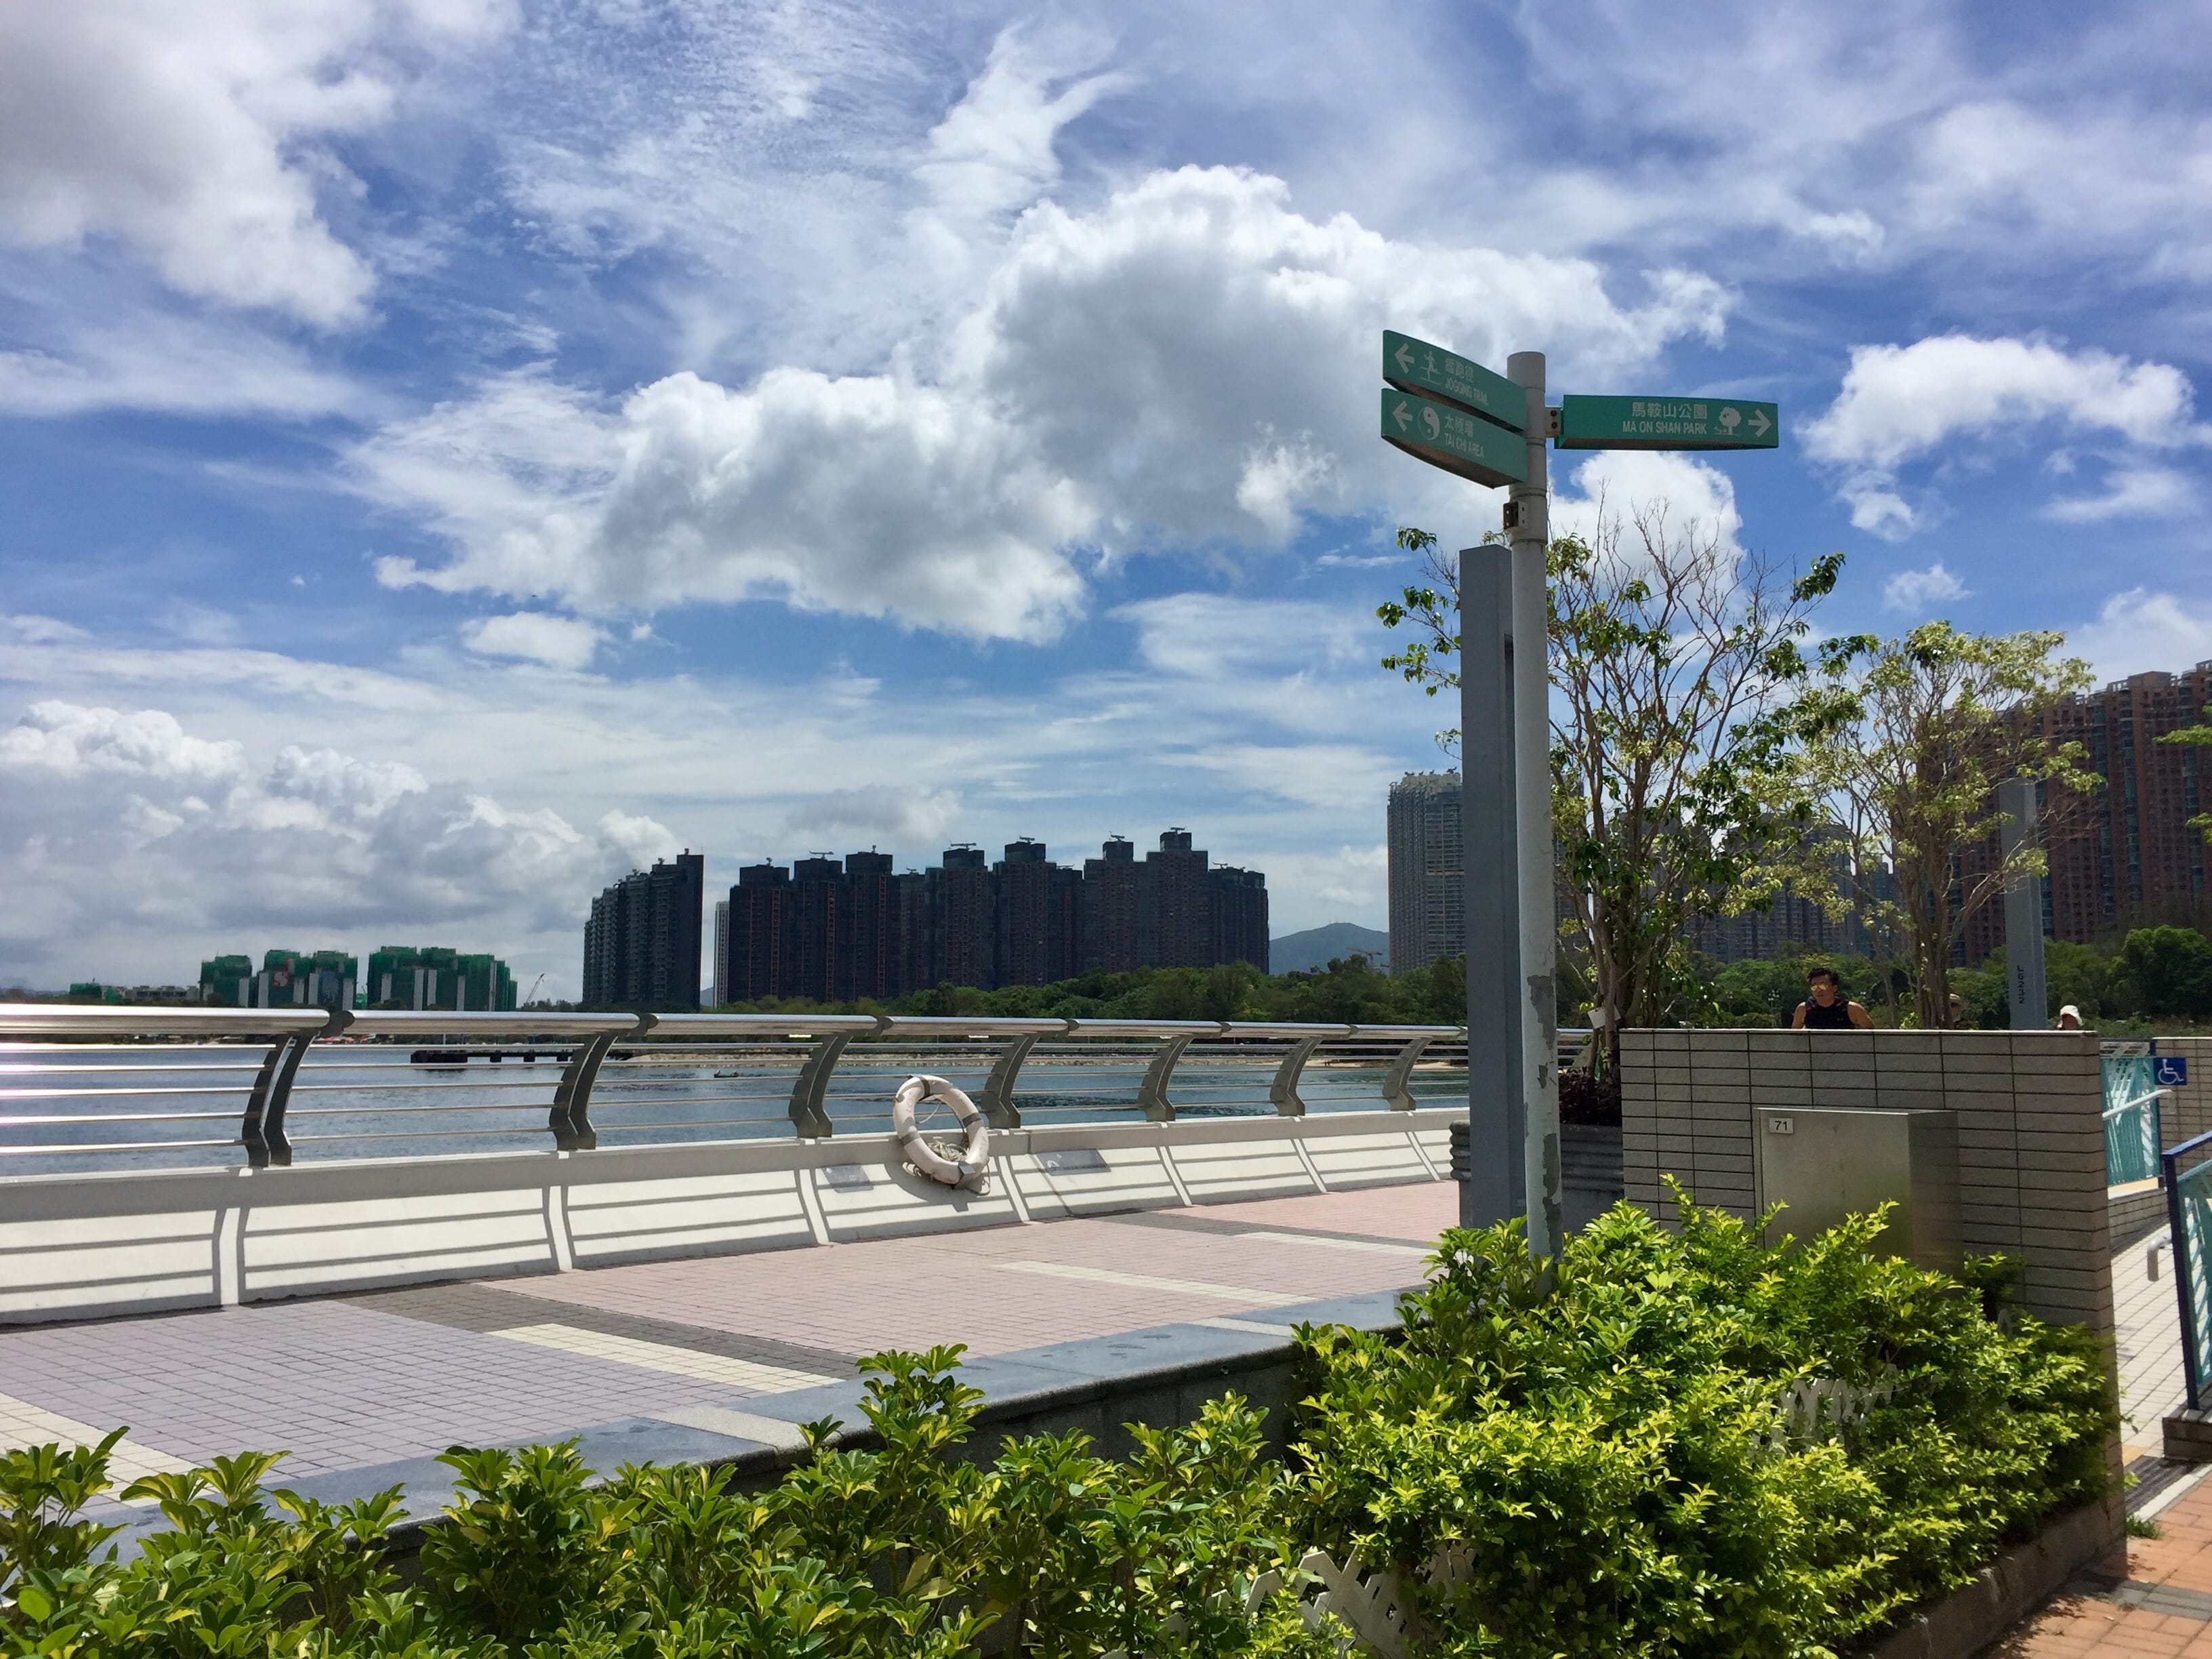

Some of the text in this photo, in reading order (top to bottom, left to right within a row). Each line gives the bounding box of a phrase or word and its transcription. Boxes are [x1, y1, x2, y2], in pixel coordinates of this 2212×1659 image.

[1445, 377, 1472, 398] JOGGING
[1632, 402, 1707, 419] 馬鞍山公園
[1622, 421, 1707, 435] MA ON SHAN PARK
[1444, 432, 1484, 459] TAI CHI AREA
[1774, 1120, 1788, 1131] 71
